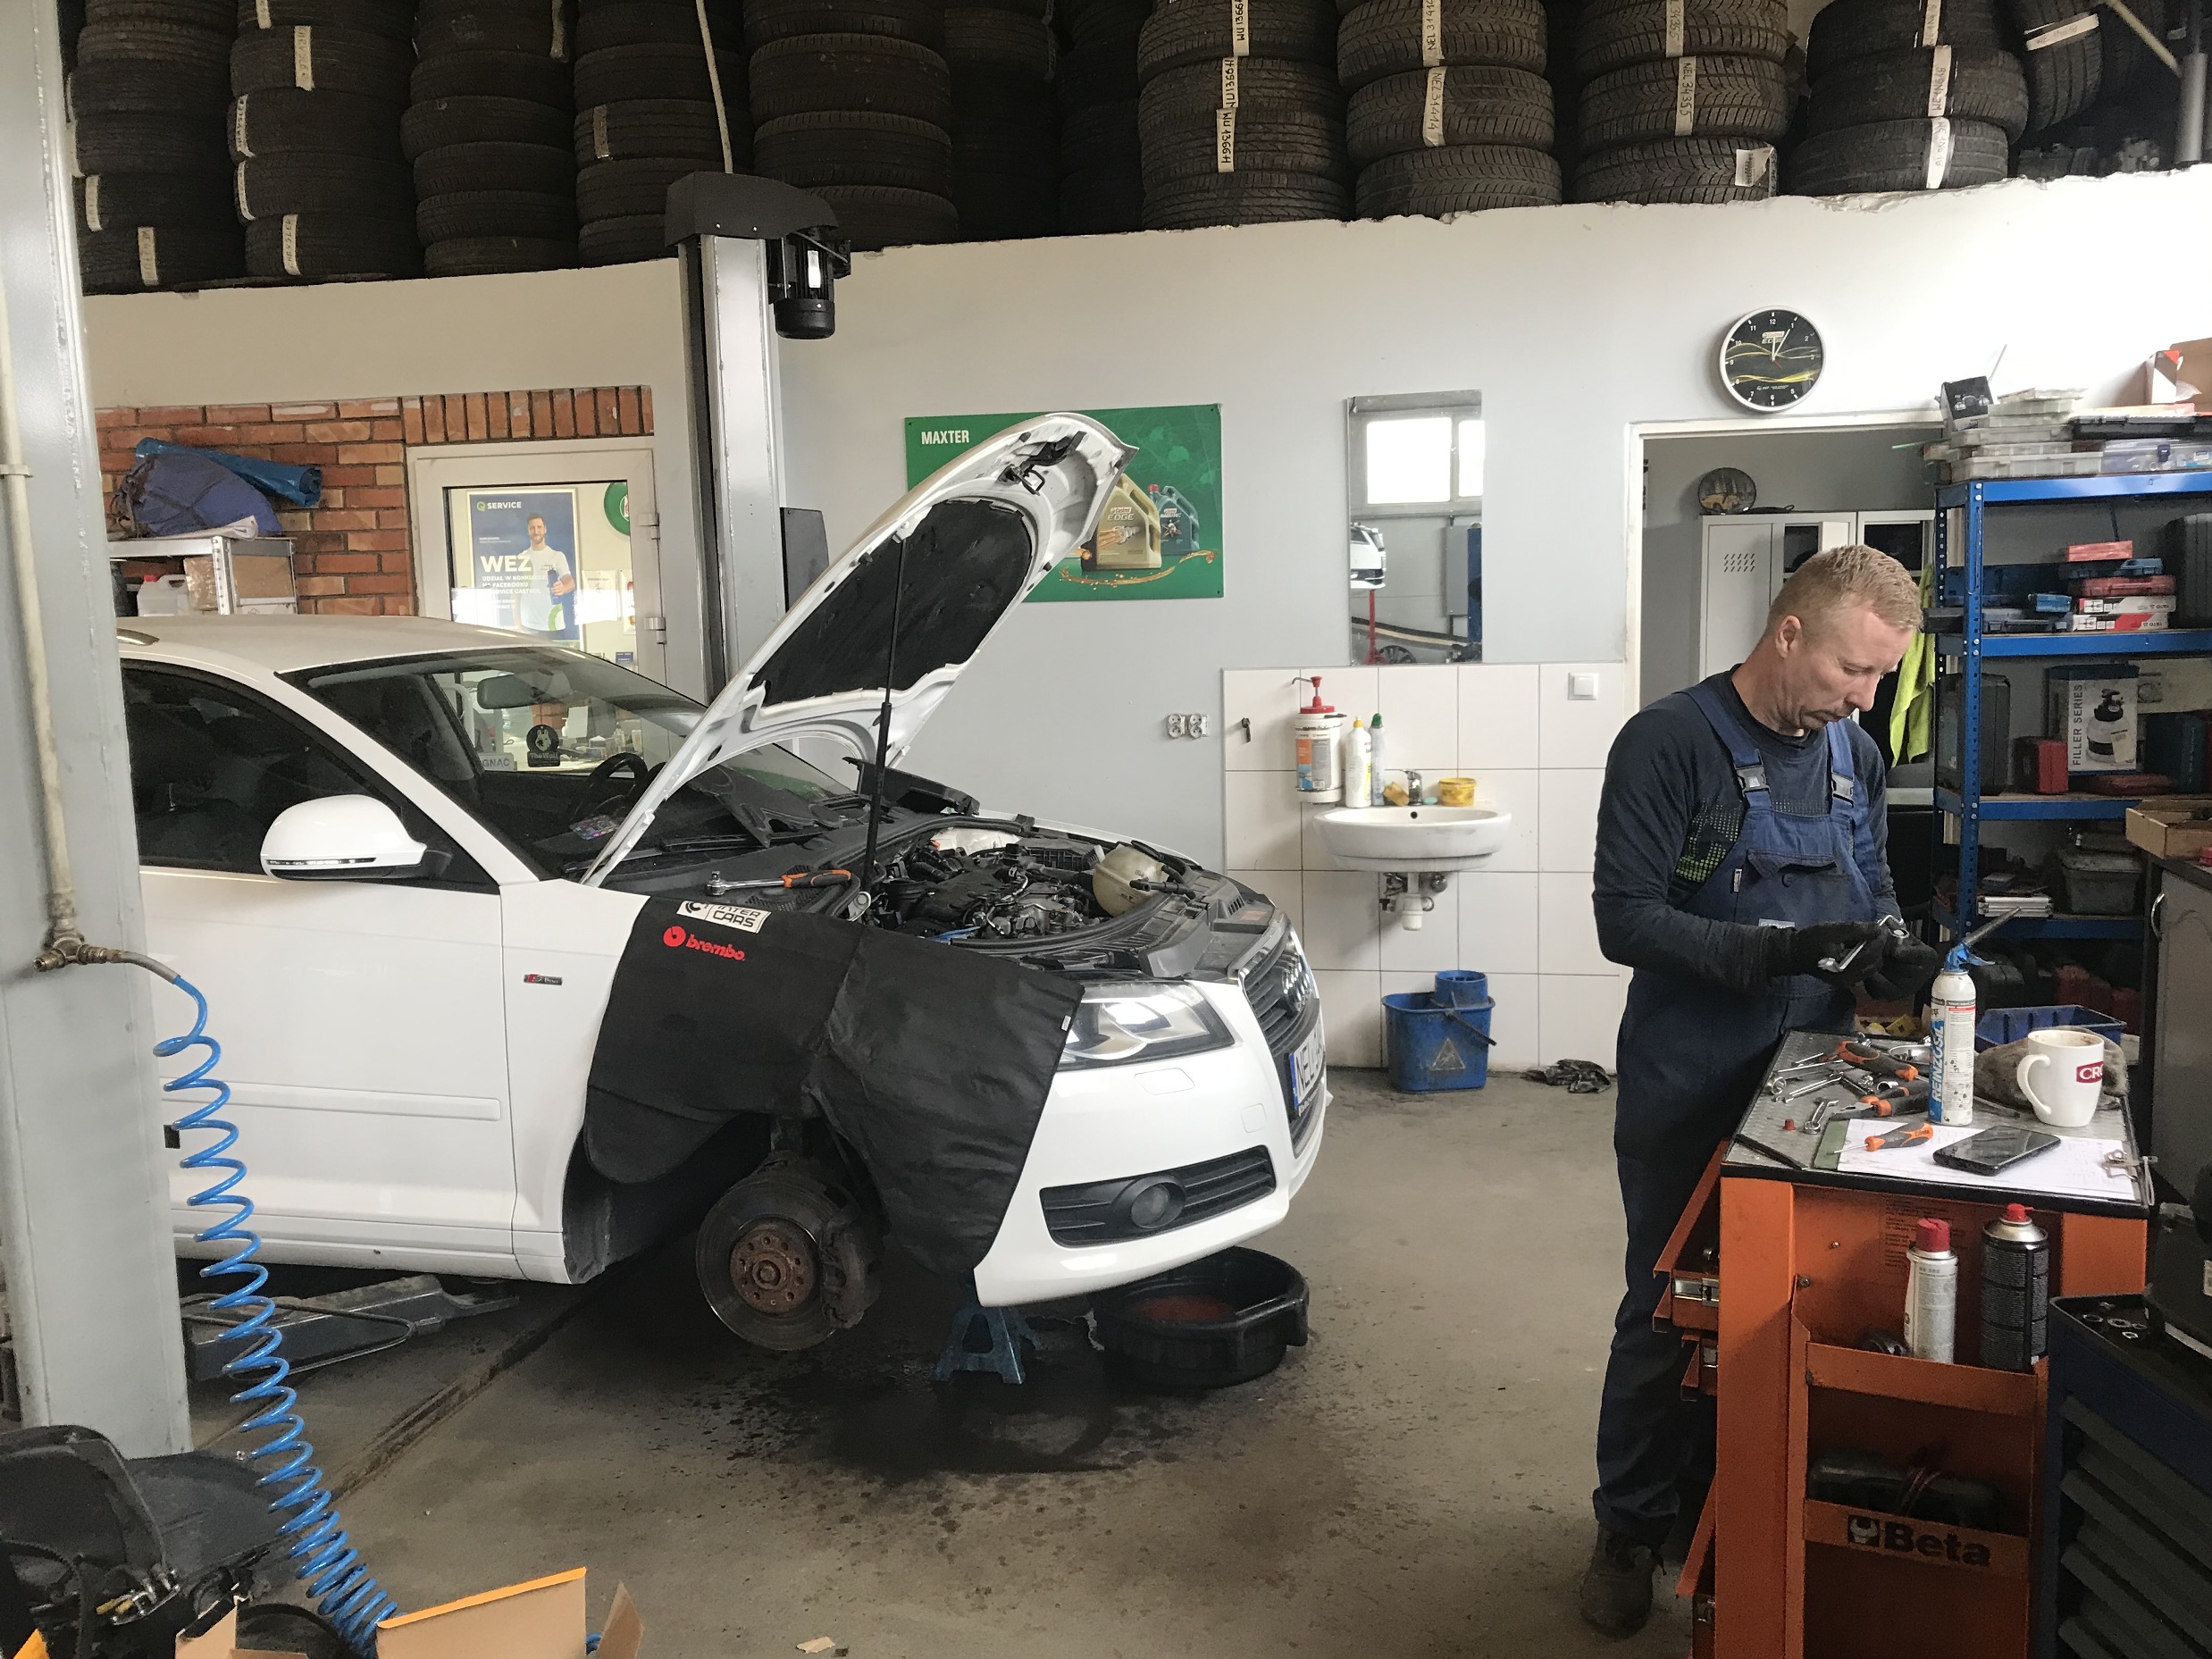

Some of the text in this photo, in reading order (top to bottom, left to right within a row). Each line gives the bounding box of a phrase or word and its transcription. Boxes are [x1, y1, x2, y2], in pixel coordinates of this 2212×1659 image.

[1426, 33, 1436, 51] NEL
[1680, 63, 1693, 122] NEL 34355
[921, 430, 969, 445] MAXTER
[487, 501, 522, 509] SERVICE
[1107, 513, 1135, 521] EDGE
[2073, 684, 2082, 766] FILLER SERIES
[713, 910, 756, 927] CARS
[686, 934, 745, 960] brembo
[1884, 1521, 1991, 1567] Beta
